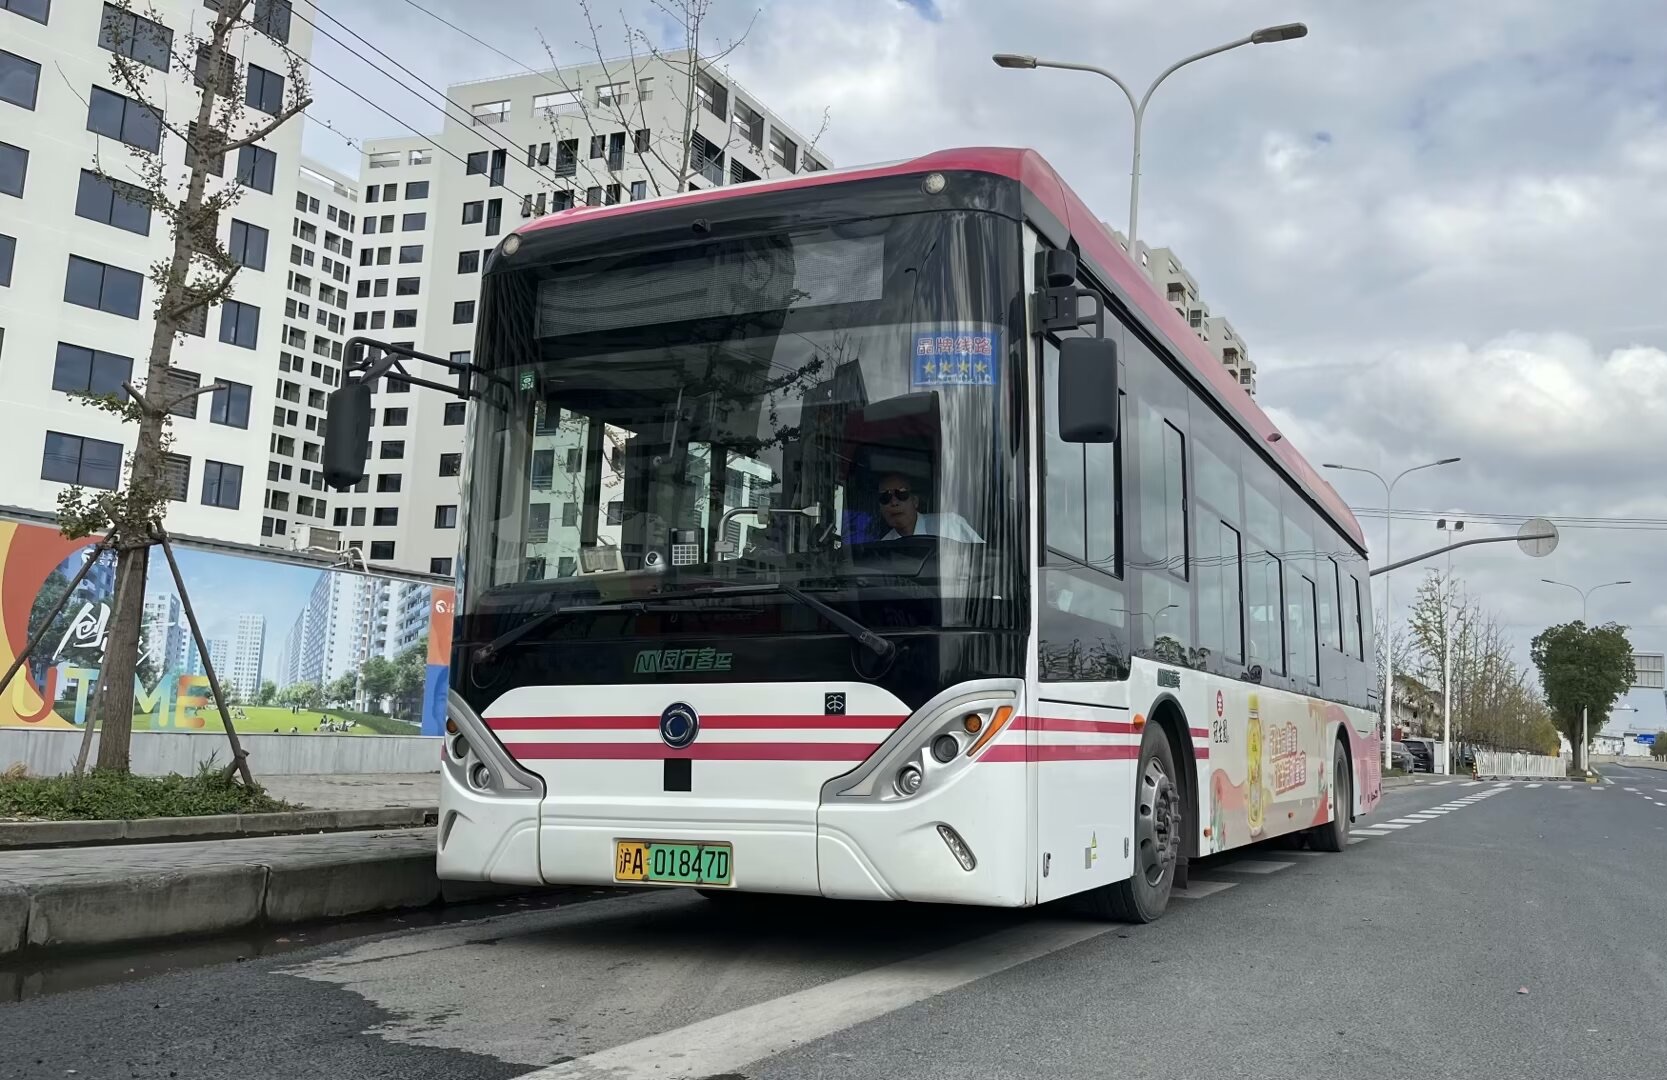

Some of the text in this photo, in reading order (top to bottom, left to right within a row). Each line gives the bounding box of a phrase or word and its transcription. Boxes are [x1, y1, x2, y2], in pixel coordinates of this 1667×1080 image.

[916, 336, 993, 356] 品牌线路
[12, 666, 210, 728] UTME
